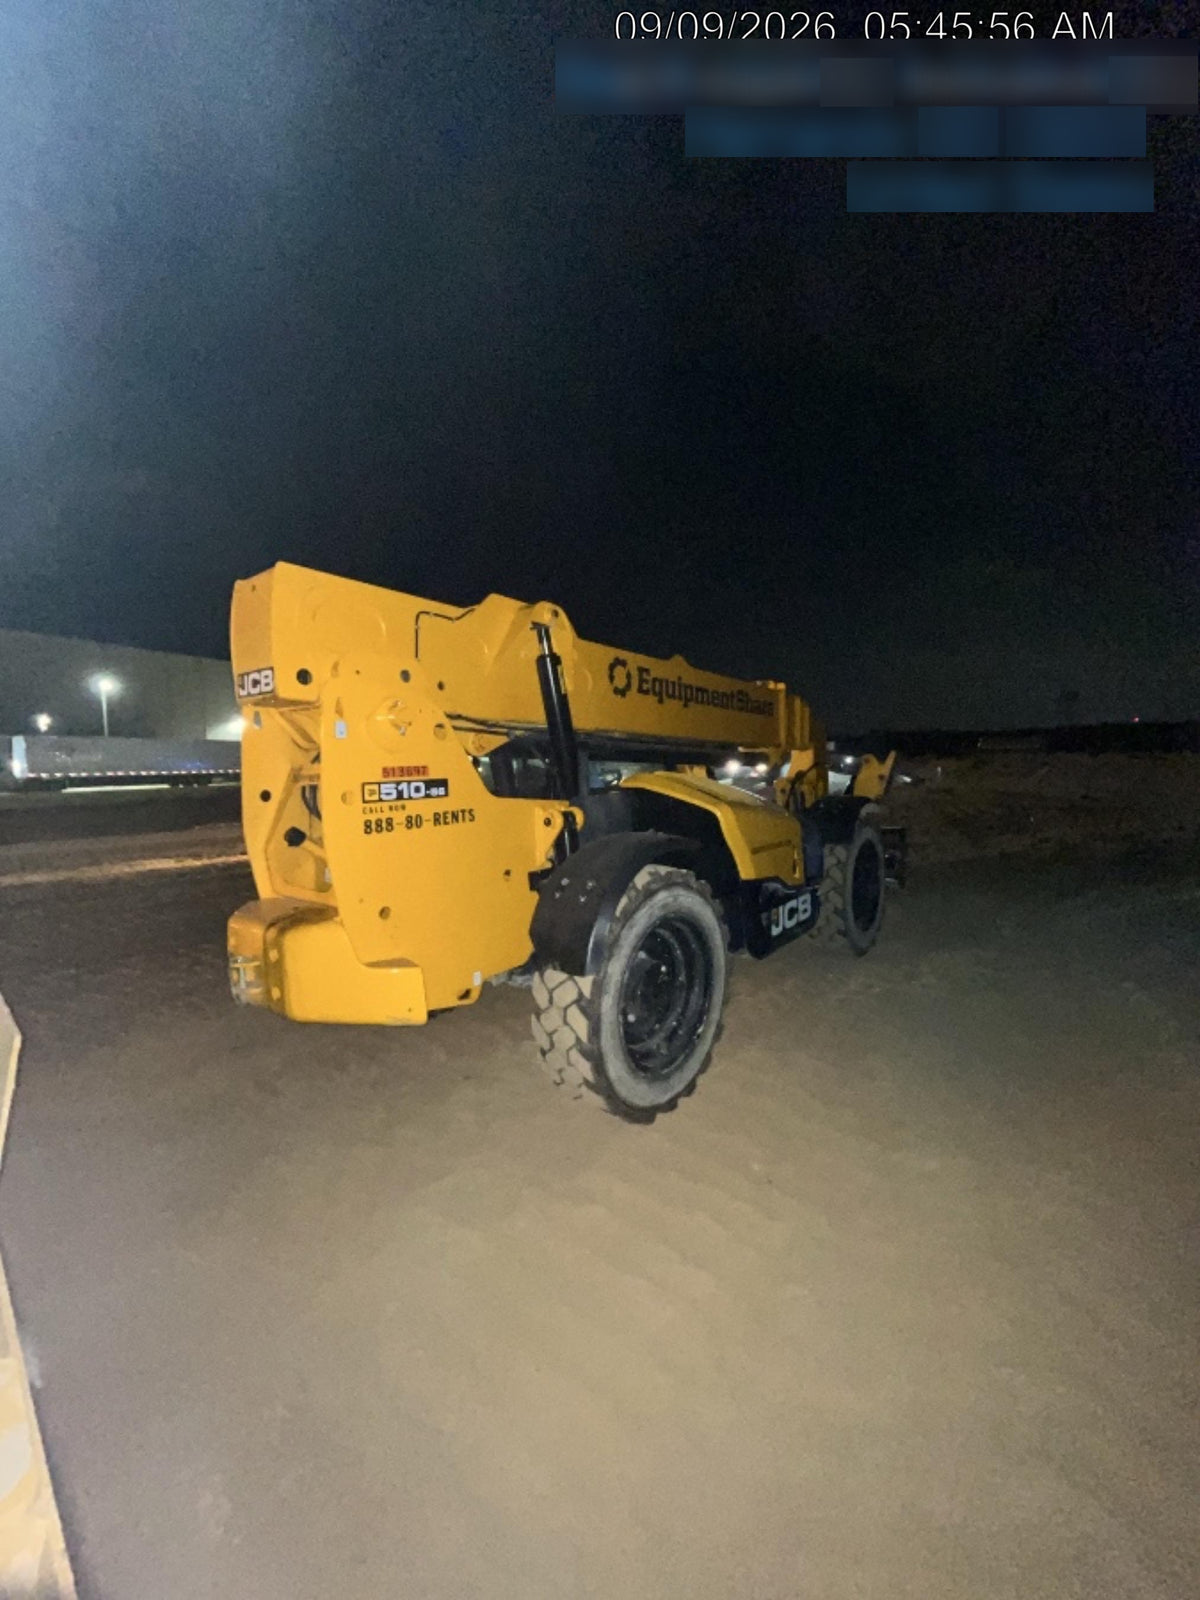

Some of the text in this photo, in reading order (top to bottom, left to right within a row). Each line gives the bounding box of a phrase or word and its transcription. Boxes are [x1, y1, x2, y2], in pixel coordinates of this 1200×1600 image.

[238, 669, 273, 696] JCB
[363, 808, 476, 835] 888-80-RENTS
[770, 892, 812, 936] JCB
